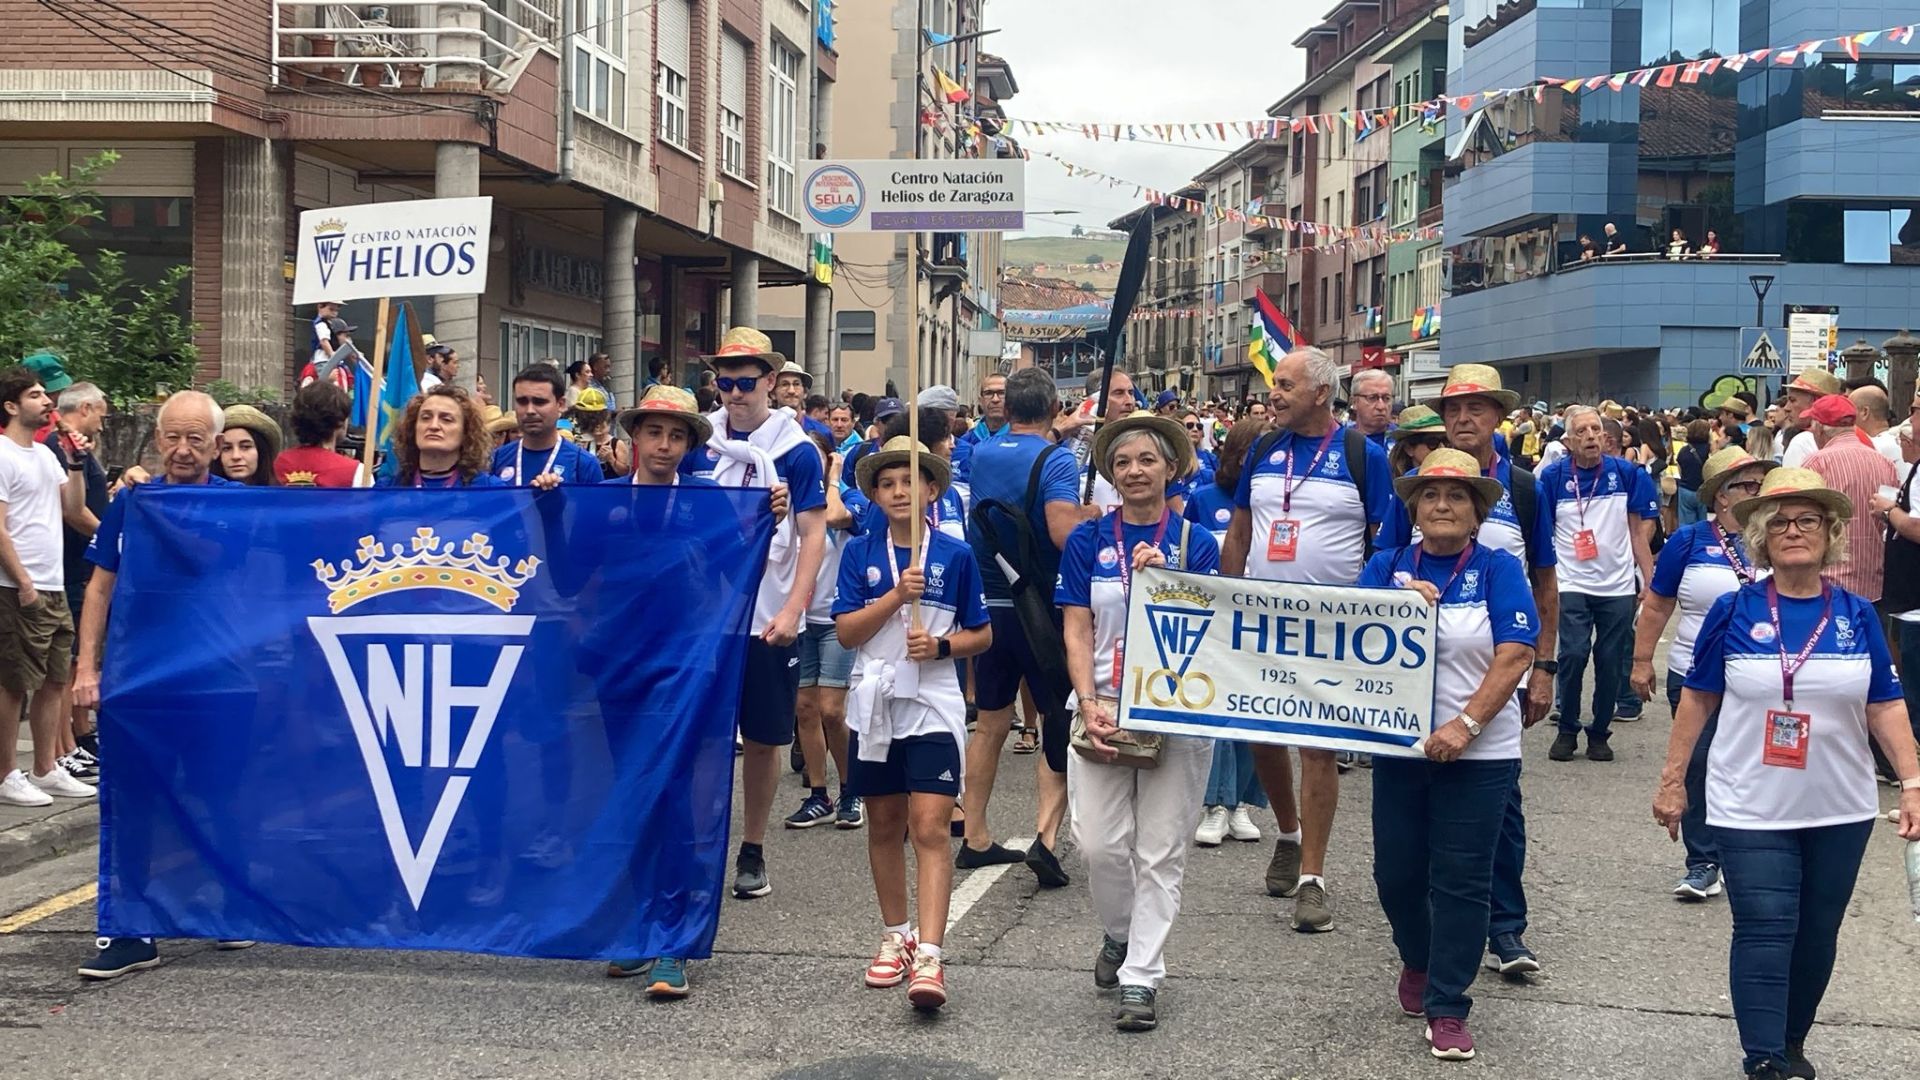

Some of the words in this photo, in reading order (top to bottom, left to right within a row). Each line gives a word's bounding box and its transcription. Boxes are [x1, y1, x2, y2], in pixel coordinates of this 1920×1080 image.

[891, 171, 938, 185] Centro
[942, 171, 1004, 185] Natación
[814, 193, 855, 205] SELLA
[881, 189, 925, 202] Helios
[928, 189, 946, 202] de
[949, 190, 1014, 205] Zaragoza
[351, 229, 401, 245] CENTRO
[406, 222, 478, 240] NATACIÓN
[349, 241, 476, 282] HELIOS
[1587, 535, 1595, 545] 3
[1231, 591, 1310, 614] CENTRO
[1320, 599, 1429, 620] NATACIÓN
[1231, 610, 1427, 670] HELIOS
[1132, 666, 1216, 710] 100
[1260, 668, 1297, 685] 1925
[1355, 678, 1394, 696] 2025
[1226, 693, 1313, 718] SECCIÓN
[1318, 702, 1421, 732] MONTAÑA
[1801, 722, 1808, 738] 3
